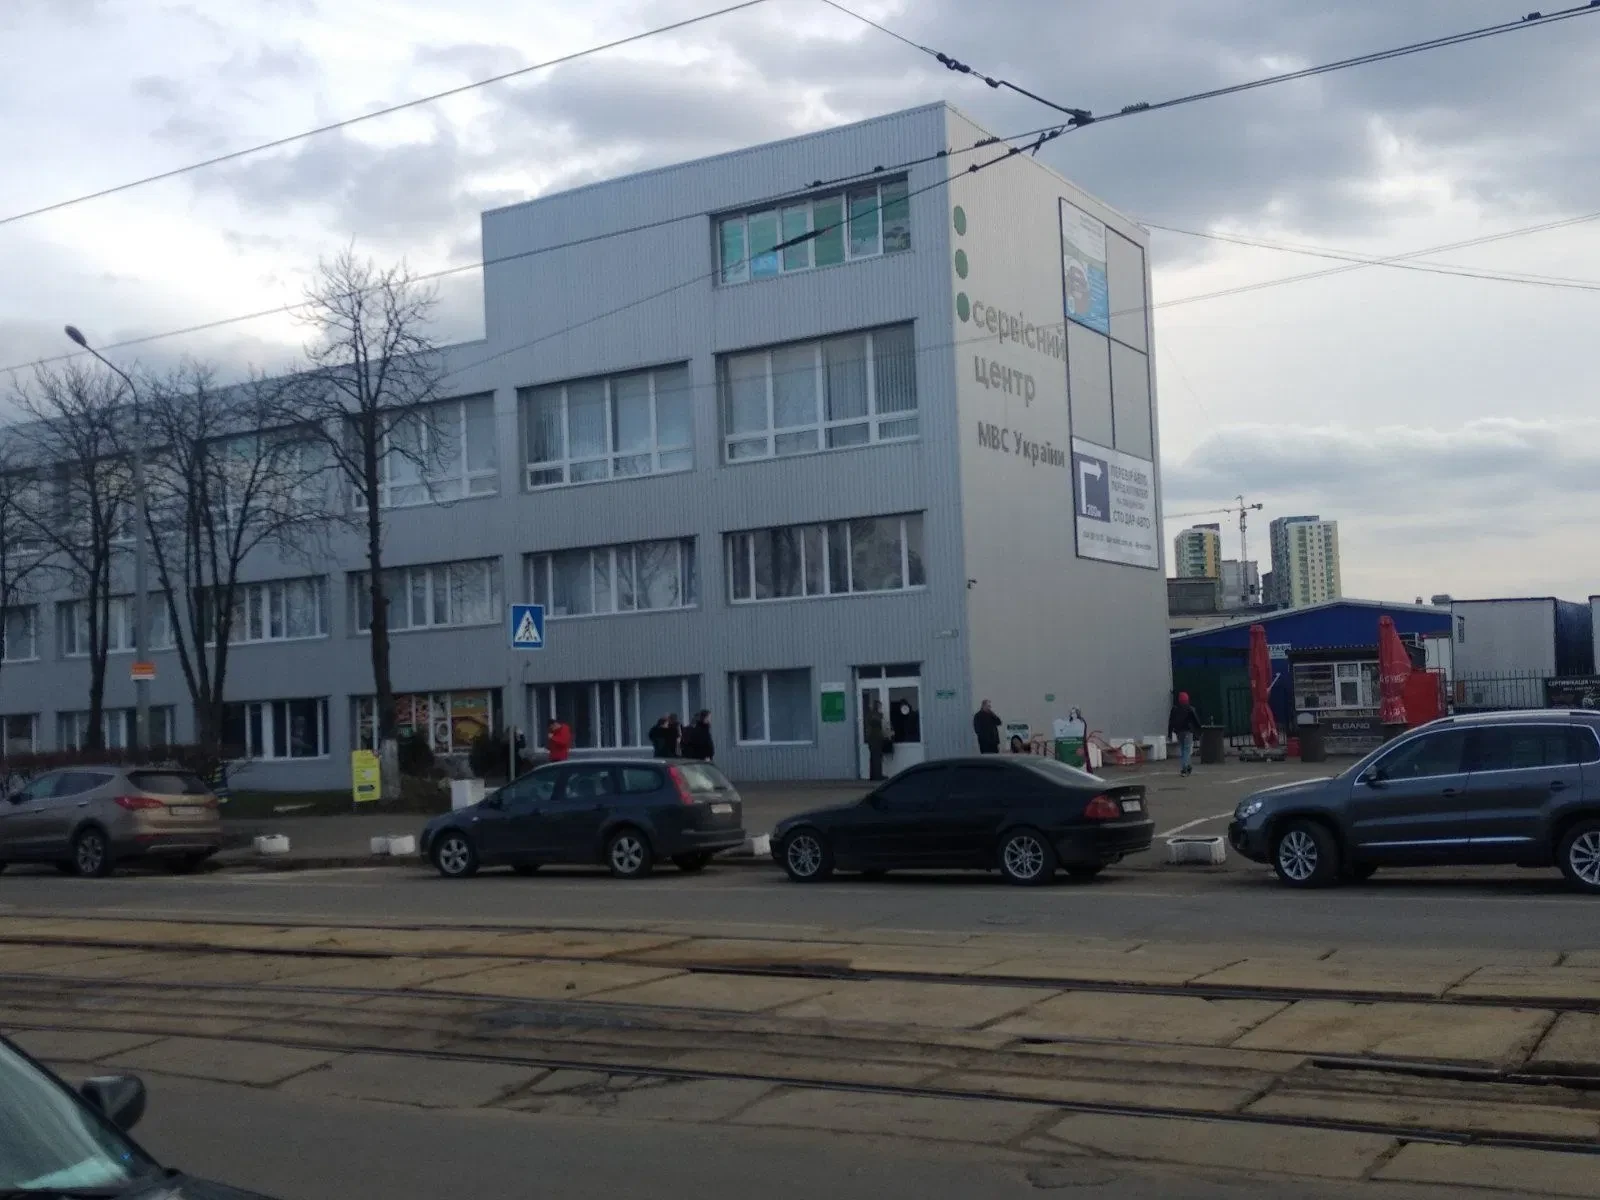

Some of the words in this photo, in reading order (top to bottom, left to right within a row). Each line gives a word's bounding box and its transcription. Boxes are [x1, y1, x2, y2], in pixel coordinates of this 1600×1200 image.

[972, 300, 1067, 362] сервісний
[974, 355, 1036, 408] центр
[978, 420, 1009, 453] МВС
[1013, 429, 1066, 468] України
